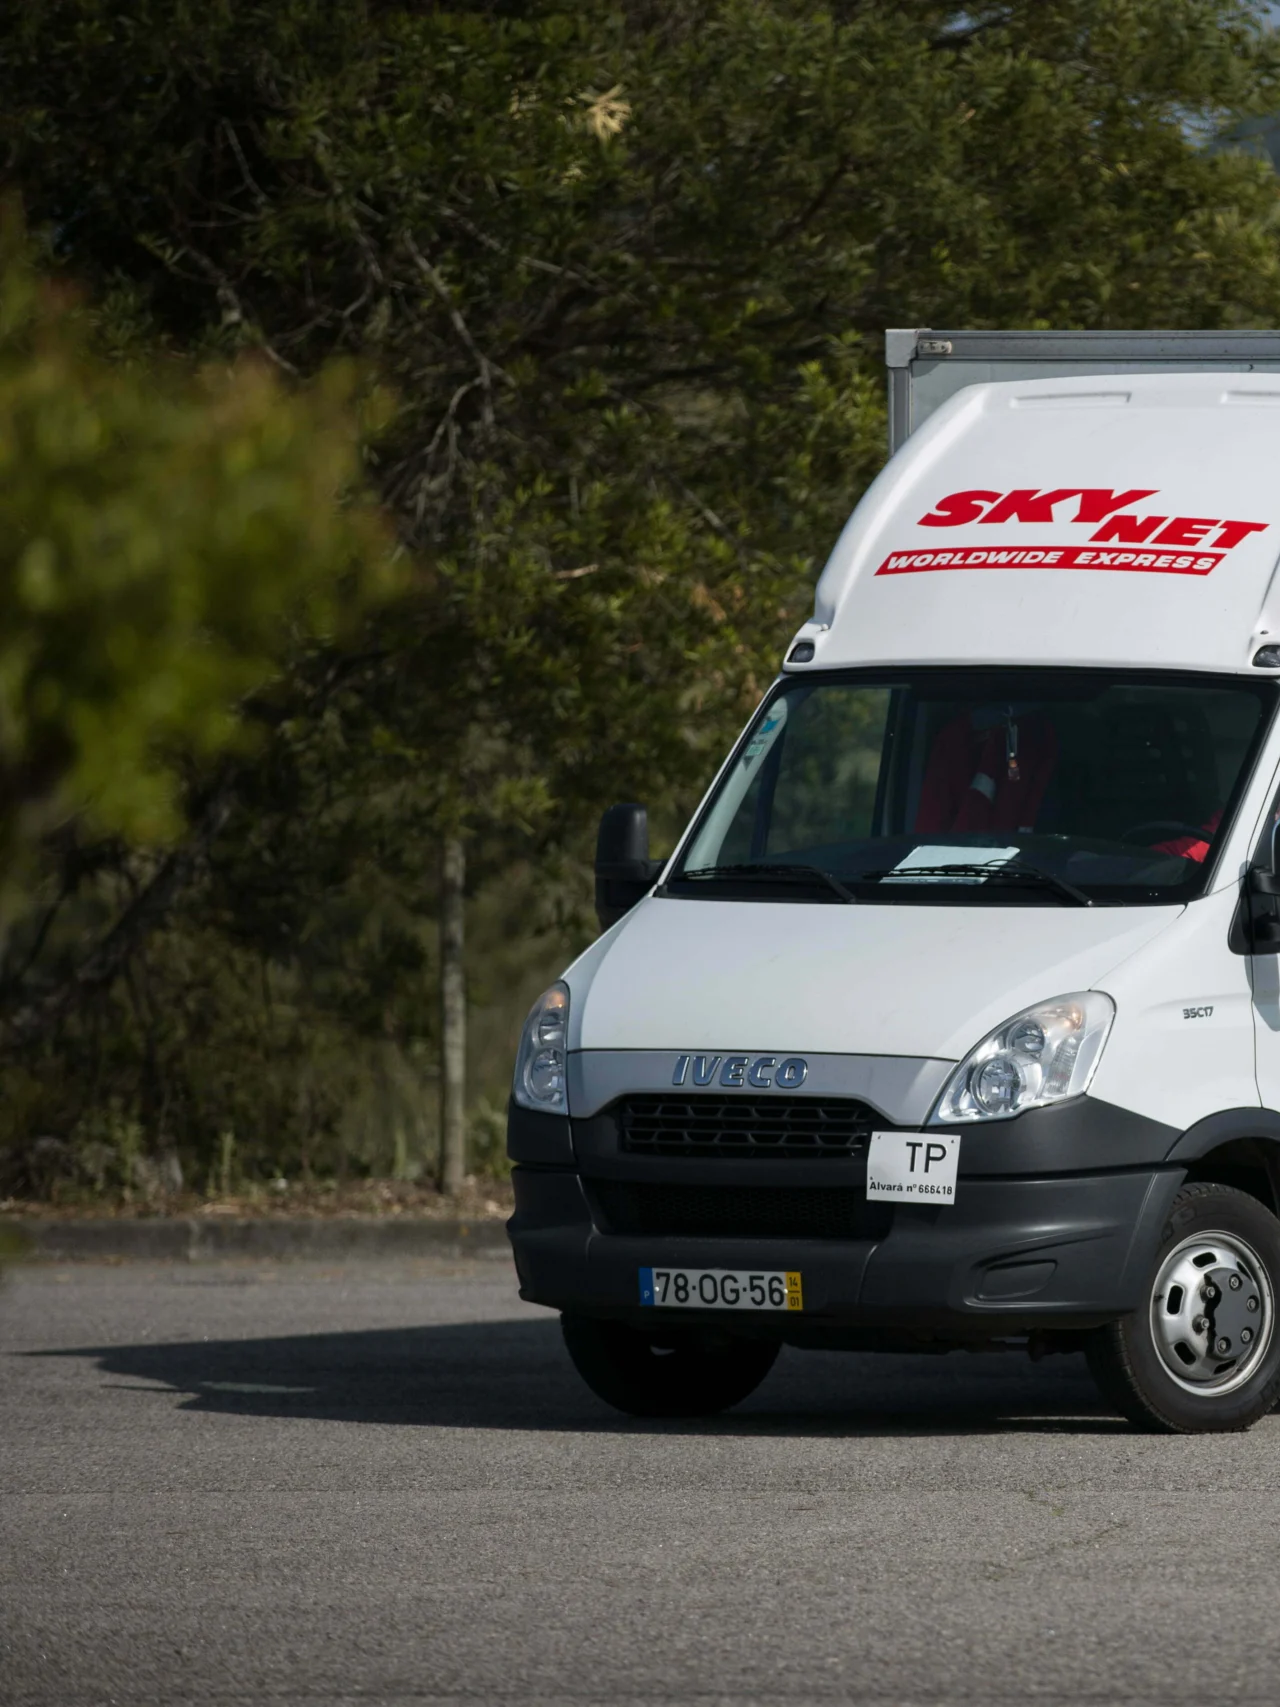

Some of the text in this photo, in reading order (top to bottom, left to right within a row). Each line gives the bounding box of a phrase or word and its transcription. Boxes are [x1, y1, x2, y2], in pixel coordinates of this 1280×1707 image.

[886, 550, 1216, 571] WORLDWIDE EXPRESS
[672, 1055, 808, 1089] IVECO
[905, 1141, 947, 1174] TP
[869, 1181, 903, 1192] Alvará
[789, 1276, 799, 1288] 14
[643, 1290, 651, 1300] P
[790, 1296, 800, 1307] 01
